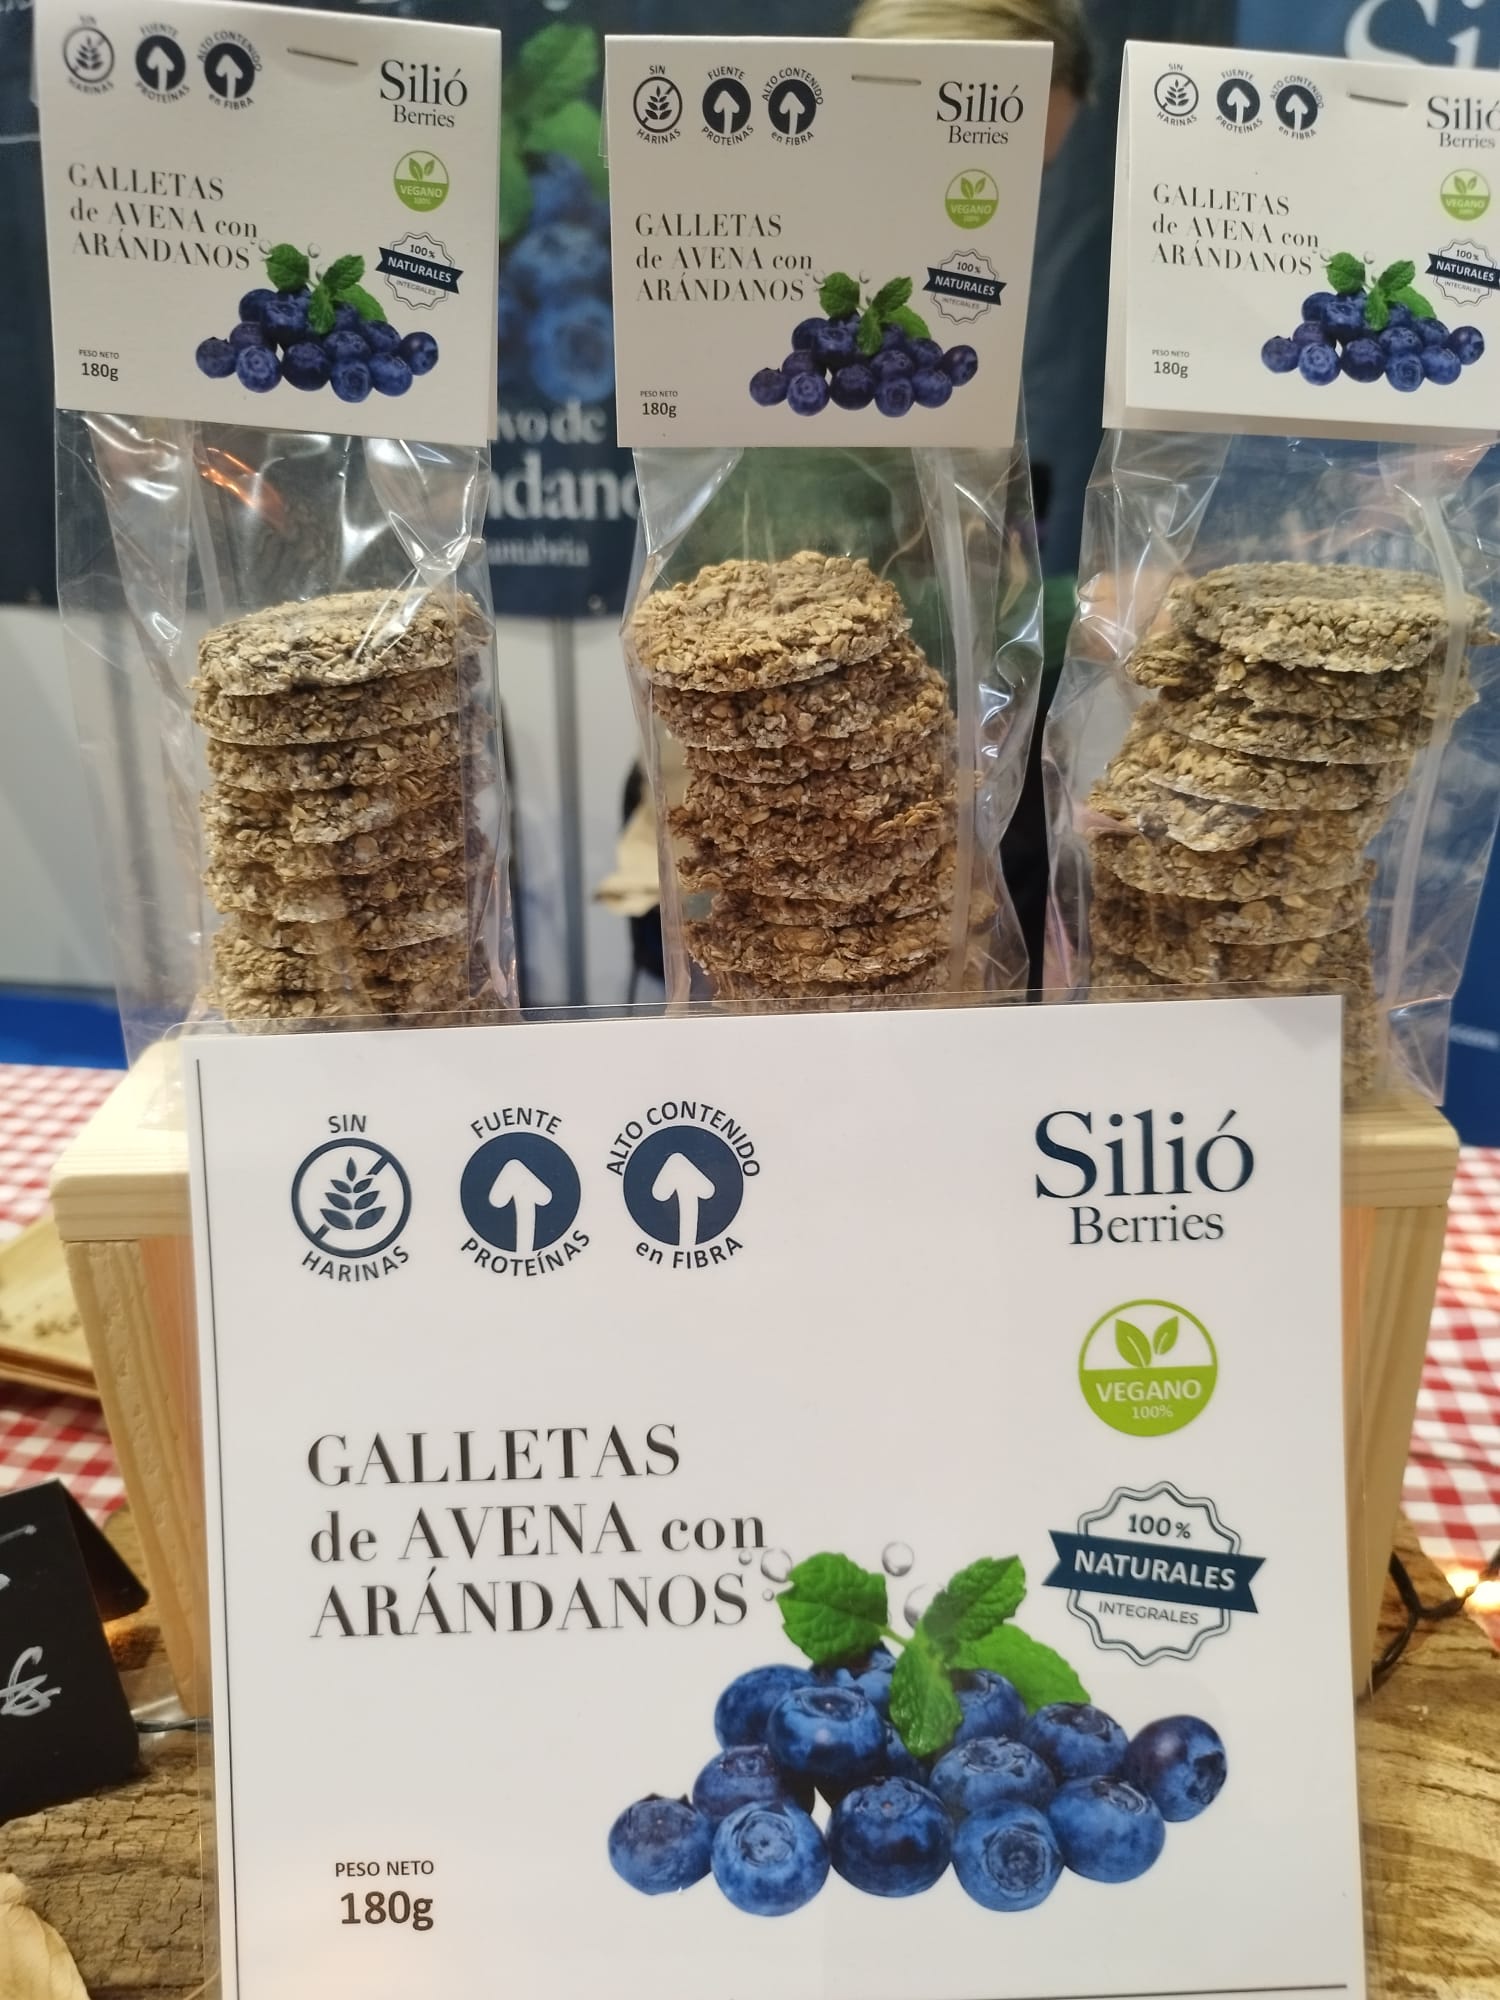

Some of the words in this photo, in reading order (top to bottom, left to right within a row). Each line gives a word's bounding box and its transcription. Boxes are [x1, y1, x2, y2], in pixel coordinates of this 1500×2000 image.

[140, 22, 179, 39] FUENTE
[197, 36, 214, 63] ALTO
[649, 65, 666, 75] SIN
[707, 66, 745, 81] FUENTE
[1168, 63, 1183, 71] SIN
[1221, 69, 1254, 81] FUENTE
[379, 59, 468, 108] Silió
[761, 76, 778, 101] ALTO
[778, 67, 824, 105] CONTENIDO
[1270, 80, 1284, 99] ALTO
[223, 97, 254, 110] FIBRA
[935, 80, 1025, 124] Silió
[392, 105, 455, 129] Berries
[1157, 112, 1197, 127] HARINAS
[637, 128, 681, 145] HARINAS
[701, 124, 755, 146] PROTEÍNAS
[771, 131, 783, 143] en
[785, 131, 815, 146] FIBRA
[948, 125, 1009, 145] Berries
[1279, 126, 1289, 137] en
[1292, 130, 1317, 140] FIBRA
[1439, 132, 1496, 149] Berries
[68, 162, 224, 201] GALLETAS
[400, 184, 443, 198] VEGANO
[951, 204, 992, 214] VEGANO
[1153, 183, 1290, 217] GALLETAS
[70, 197, 98, 222] de
[108, 201, 206, 233] AVENA
[215, 219, 258, 239] con
[635, 213, 782, 237] GALLETAS
[1152, 213, 1178, 235] de
[1186, 216, 1273, 244] AVENA
[1281, 231, 1319, 248] con
[72, 228, 250, 270] ARÁNDANOS
[636, 246, 663, 270] de
[672, 246, 764, 270] AVENA
[772, 254, 813, 270] con
[1152, 239, 1312, 276] ARÁNDANOS
[387, 256, 452, 283] NATURALES
[1436, 260, 1495, 282] NATURALES
[636, 271, 804, 302] ARÁNDANOS
[934, 275, 995, 296] NATURALES
[81, 362, 119, 382] 180g
[1153, 361, 1189, 378] 180g
[642, 402, 677, 418] 180g
[328, 1114, 367, 1134] SIN
[469, 1106, 563, 1139] FUENTE
[606, 1120, 644, 1178] ALTO
[646, 1101, 761, 1178] CONTENIDO
[1034, 1108, 1256, 1200] Silió
[1068, 1204, 1225, 1246] Berries
[301, 1244, 410, 1284] HARINAS
[459, 1228, 591, 1278] PROTEÍNAS
[635, 1240, 665, 1265] en
[671, 1235, 745, 1271] FIBRA
[1095, 1377, 1202, 1404] VEGANO
[1131, 1404, 1174, 1421] 100%
[307, 1423, 681, 1487] GALLETAS
[310, 1510, 378, 1563] de
[400, 1500, 643, 1560] AVENA
[660, 1514, 768, 1554] con
[1073, 1547, 1237, 1593] NATURALES
[309, 1565, 749, 1639] ARÁNDANOS
[1098, 1600, 1200, 1626] INTEGRALES
[334, 1860, 381, 1878] PESO
[386, 1859, 435, 1876] NETO
[339, 1890, 435, 1931] 180g
